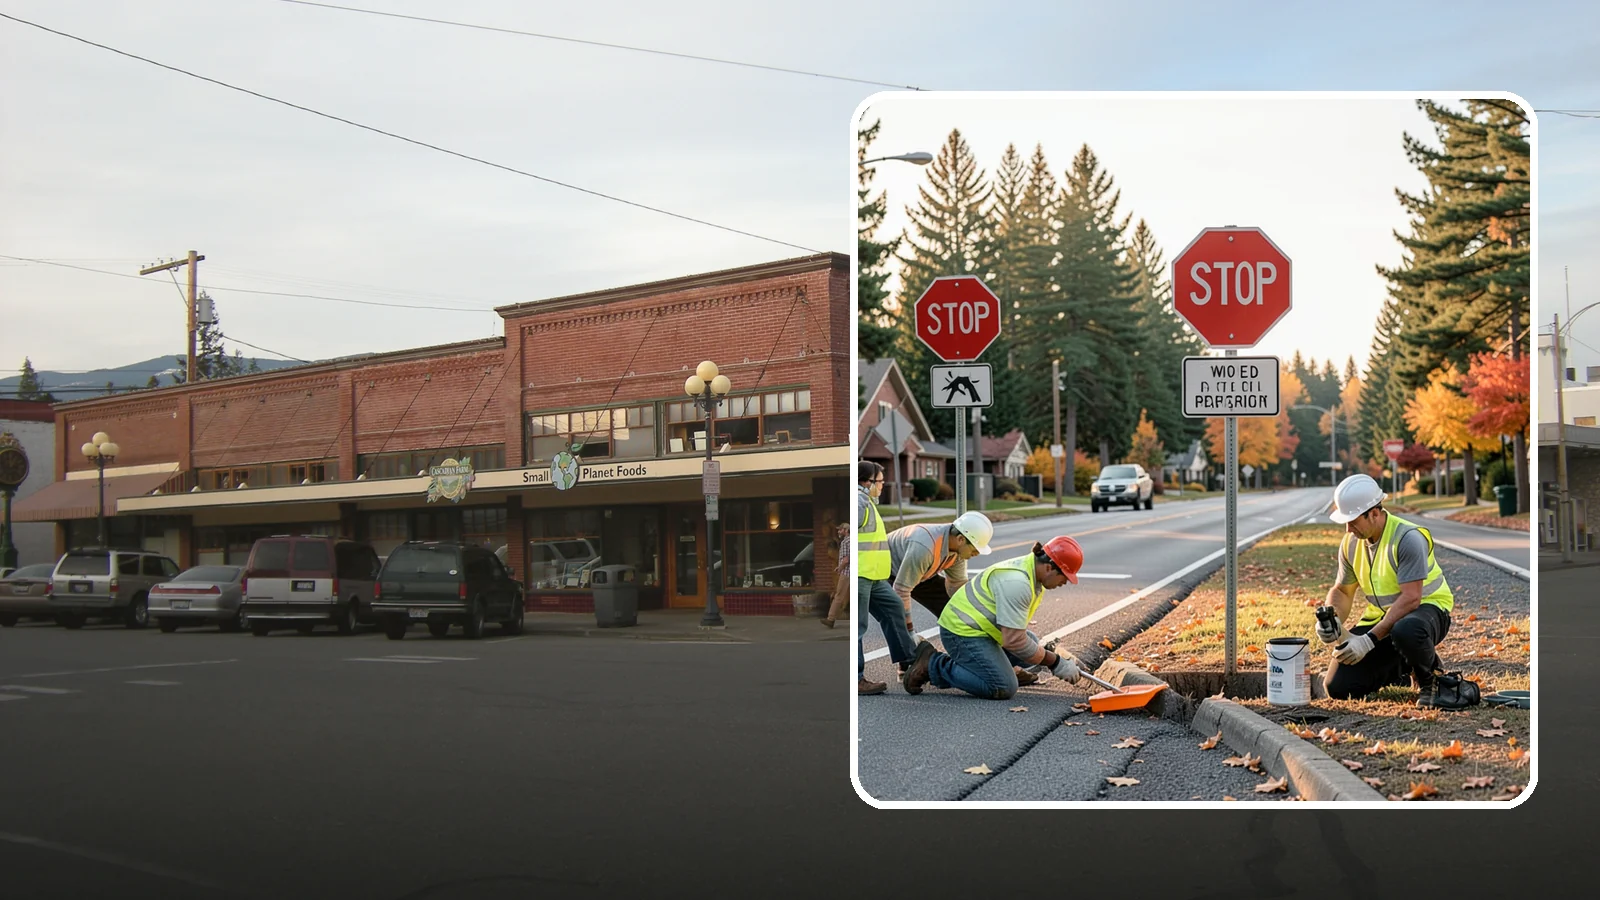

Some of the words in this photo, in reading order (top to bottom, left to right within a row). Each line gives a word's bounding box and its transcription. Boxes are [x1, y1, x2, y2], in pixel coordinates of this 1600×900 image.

[1190, 260, 1277, 306] STOP
[927, 302, 990, 335] STOP
[522, 471, 548, 482] Small
[582, 468, 614, 479] Planet
[616, 464, 646, 476] Foods
